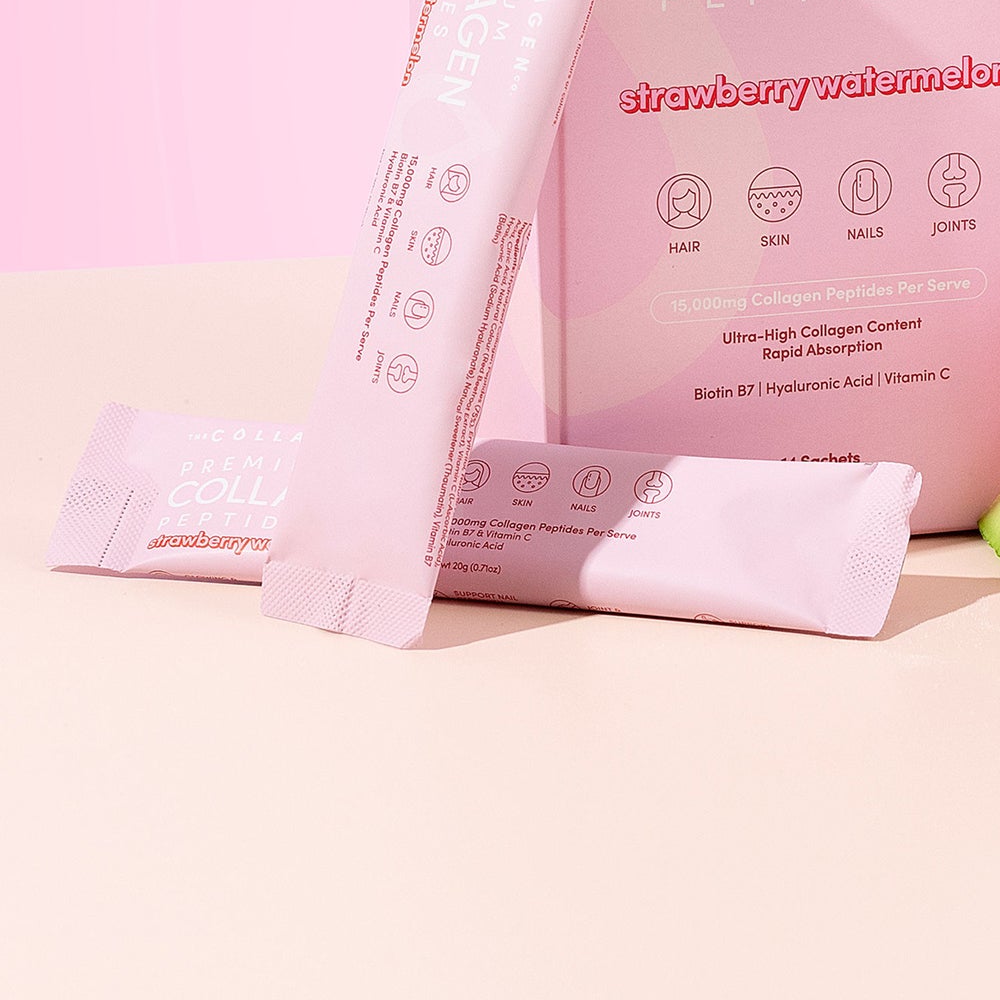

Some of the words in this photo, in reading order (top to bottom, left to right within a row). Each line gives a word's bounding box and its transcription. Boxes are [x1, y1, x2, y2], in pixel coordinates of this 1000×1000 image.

[618, 74, 809, 115] strawberry
[378, 150, 399, 203] Hyaluronic
[396, 152, 409, 181] Biotin
[424, 167, 438, 190] HAIR
[391, 182, 400, 195] B7
[395, 155, 419, 207] 15,000mg
[371, 204, 382, 228] Acid
[378, 207, 392, 245] Vitamin
[491, 213, 507, 245] (Biotin)
[931, 218, 977, 237] JOINTS
[383, 209, 403, 257] Collagen
[407, 230, 418, 252] SKIN
[496, 216, 515, 262] Hyaluronic
[760, 234, 790, 247] SKIN
[847, 226, 884, 240] NAILS
[373, 246, 381, 254] C
[668, 241, 700, 254] HAIR
[369, 259, 389, 308] Peptides
[493, 263, 502, 282] Acid
[500, 265, 509, 286] Acid,
[389, 291, 402, 318] NAILS
[482, 283, 498, 321] (Sodium
[492, 288, 505, 321] Natural
[671, 296, 748, 315] 15,000mg
[751, 290, 822, 308] Collagen
[825, 280, 894, 303] Peptides
[897, 281, 924, 295] Per
[927, 277, 971, 292] Serve
[364, 310, 376, 328] Per
[722, 327, 797, 345] Ultra-High
[800, 322, 863, 339] Collagen
[867, 317, 922, 333] Content
[356, 330, 370, 362] Serve
[484, 322, 497, 351] Colour
[466, 321, 488, 379] Hyaluronate),
[478, 352, 489, 373] (Red
[762, 344, 803, 362] Rapid
[806, 339, 883, 357] Absorption
[371, 350, 385, 385] JOINTS
[465, 375, 482, 411] Beetroot
[694, 385, 733, 401] Biotin
[738, 384, 755, 397] B7
[766, 377, 841, 397] Hyaluronic
[844, 373, 874, 389] Acid
[884, 369, 936, 385] Vitamin
[940, 367, 950, 380] C
[456, 381, 471, 414] Natural
[447, 415, 461, 461] Sweetener
[452, 449, 464, 483] Vitamin
[432, 462, 452, 519] (Thaumatin),
[450, 484, 457, 492] C
[511, 498, 533, 507] SKIN
[570, 503, 597, 513] NAILS
[627, 509, 661, 520] JOINTS
[147, 530, 250, 555] strawberry
[426, 520, 440, 554] Vitamin
[463, 529, 475, 538] B7
[476, 530, 484, 538] &
[486, 531, 521, 541] Vitamin
[523, 533, 533, 542] C
[489, 518, 536, 531] Collagen
[538, 523, 584, 535] Peptides
[586, 527, 605, 537] Per
[607, 529, 637, 541] Serve
[446, 539, 481, 549] luronic
[482, 541, 504, 551] Acid
[422, 554, 433, 567] B7
[453, 561, 468, 573] 20g
[470, 563, 502, 575] (0.71oz)
[453, 590, 497, 601] SUPPORT
[498, 594, 517, 602] NAIL
